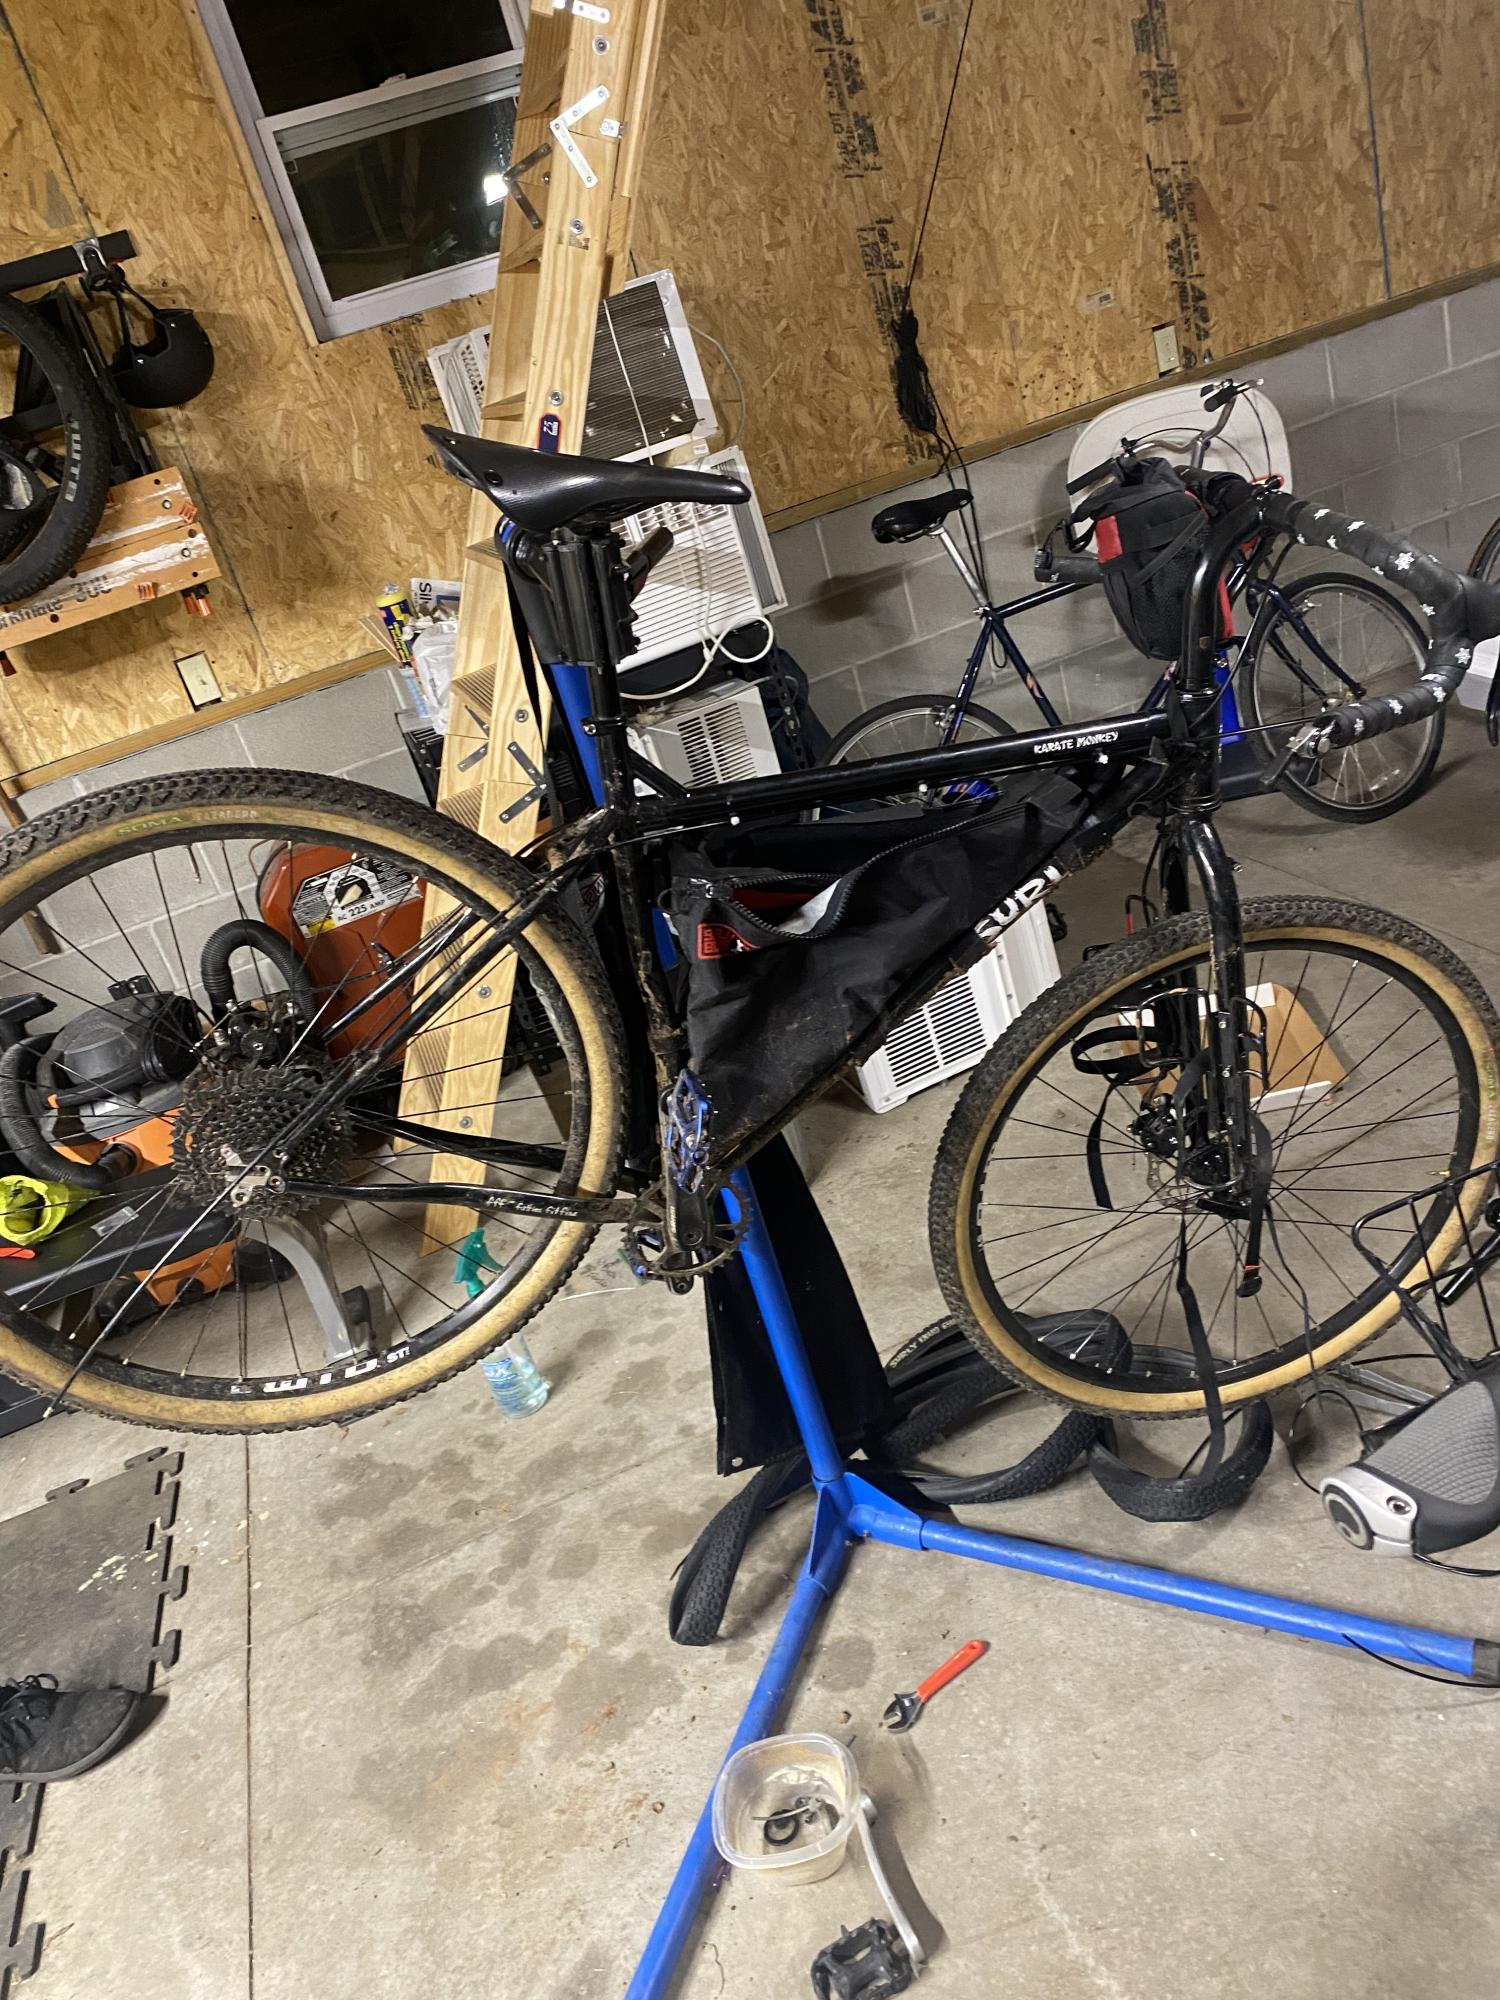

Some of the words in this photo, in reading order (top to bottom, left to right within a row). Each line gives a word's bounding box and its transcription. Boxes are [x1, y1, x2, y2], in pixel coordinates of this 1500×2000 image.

[419, 581, 433, 605] Sil
[1033, 738, 1075, 754] KARATE
[1076, 730, 1119, 748] MONKEY
[348, 904, 369, 918] 225
